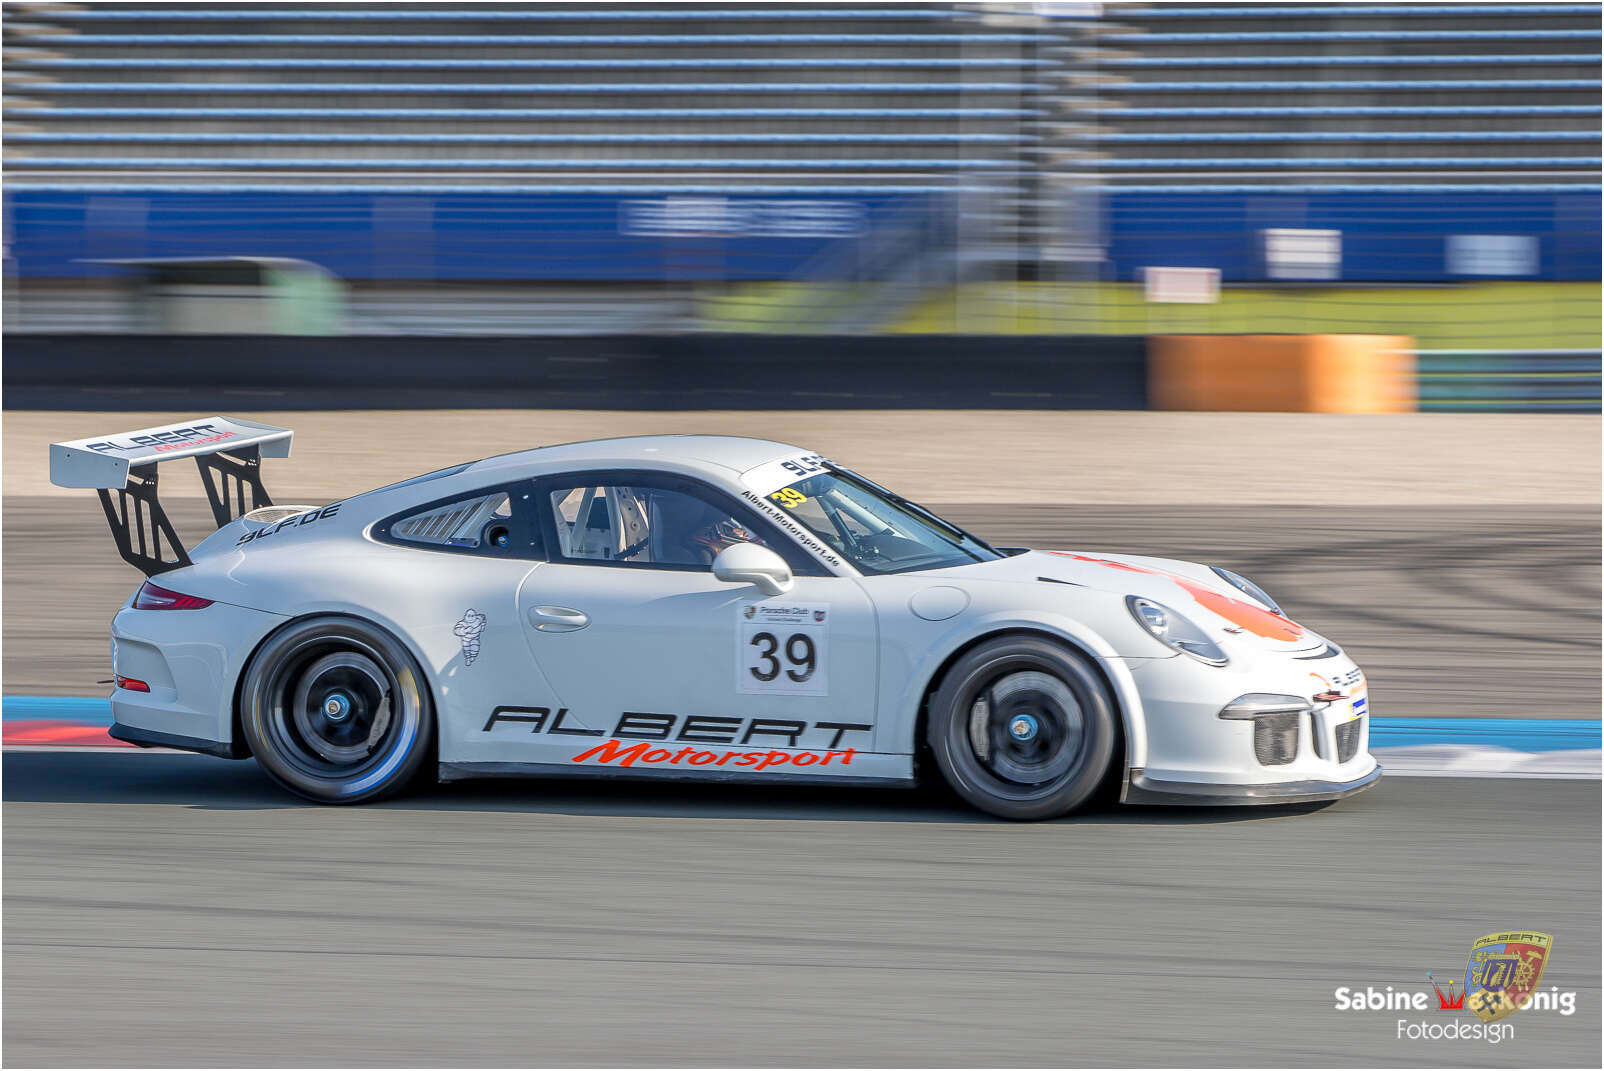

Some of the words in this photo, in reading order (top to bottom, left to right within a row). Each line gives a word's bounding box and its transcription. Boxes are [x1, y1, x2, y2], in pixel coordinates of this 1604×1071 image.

[86, 424, 216, 453] ALBERT
[770, 487, 808, 508] 39
[741, 490, 840, 567] Albert-Motorsport.de
[749, 631, 816, 682] 39
[482, 705, 873, 749] ALBERT
[571, 738, 856, 771] Motorsport
